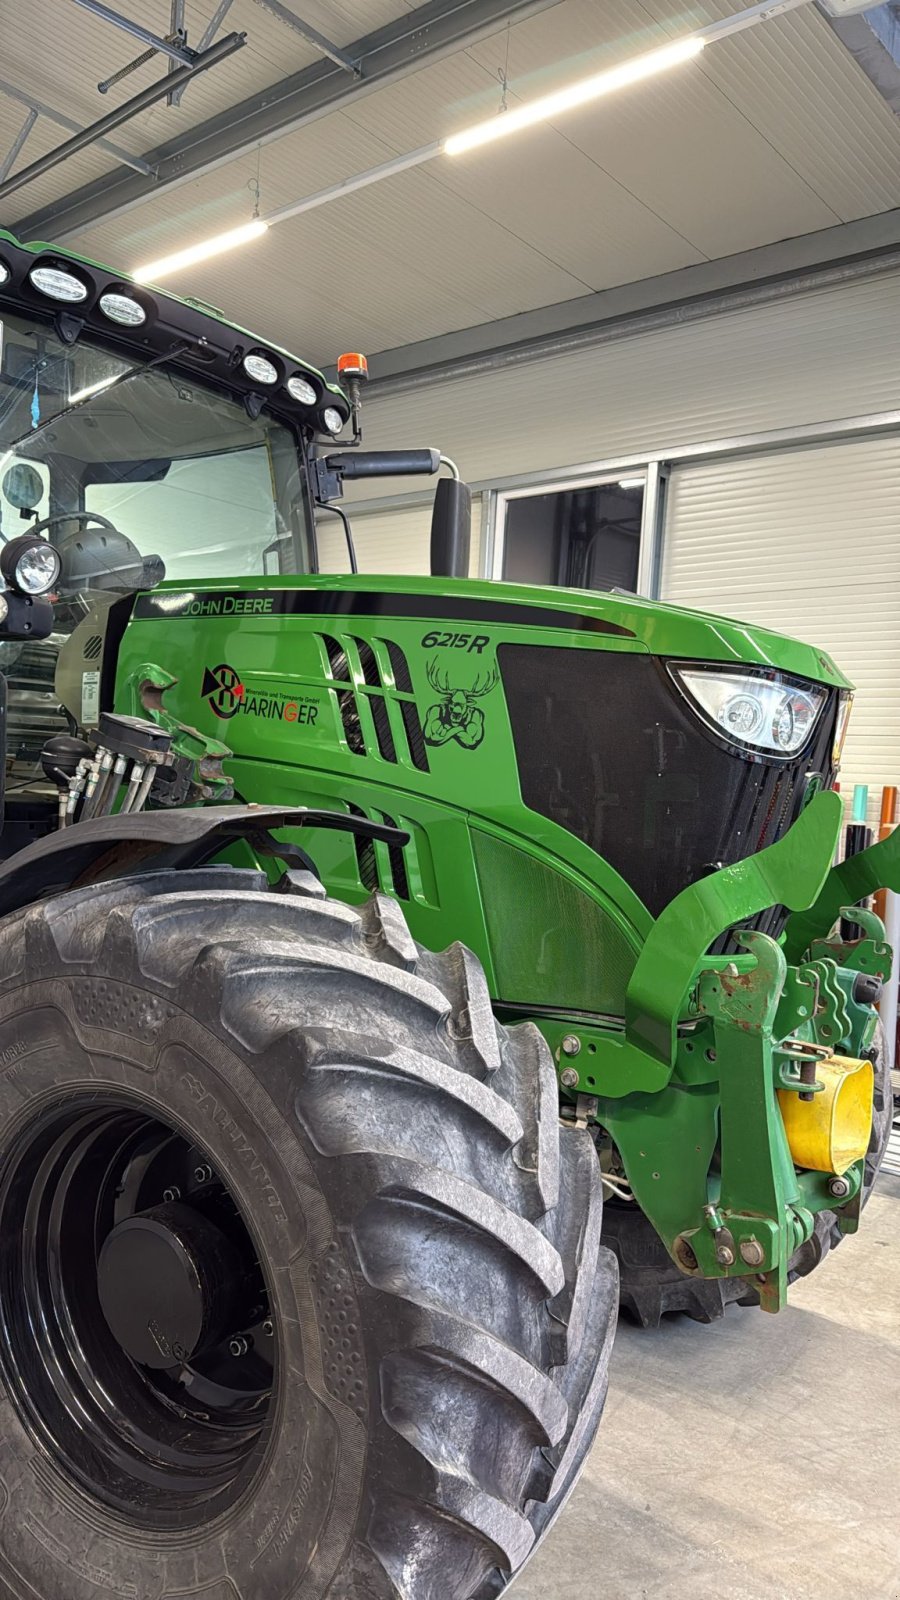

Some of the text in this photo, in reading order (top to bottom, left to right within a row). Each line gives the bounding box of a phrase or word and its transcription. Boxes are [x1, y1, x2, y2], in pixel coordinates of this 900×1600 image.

[182, 597, 274, 615] JOHN DEERE
[421, 631, 490, 654] 6215R
[269, 690, 278, 698] und
[279, 692, 304, 702] Transporte
[304, 696, 320, 704] GmbH
[237, 695, 318, 726] HARINGER
[196, 1092, 288, 1224] ALLIANCE
